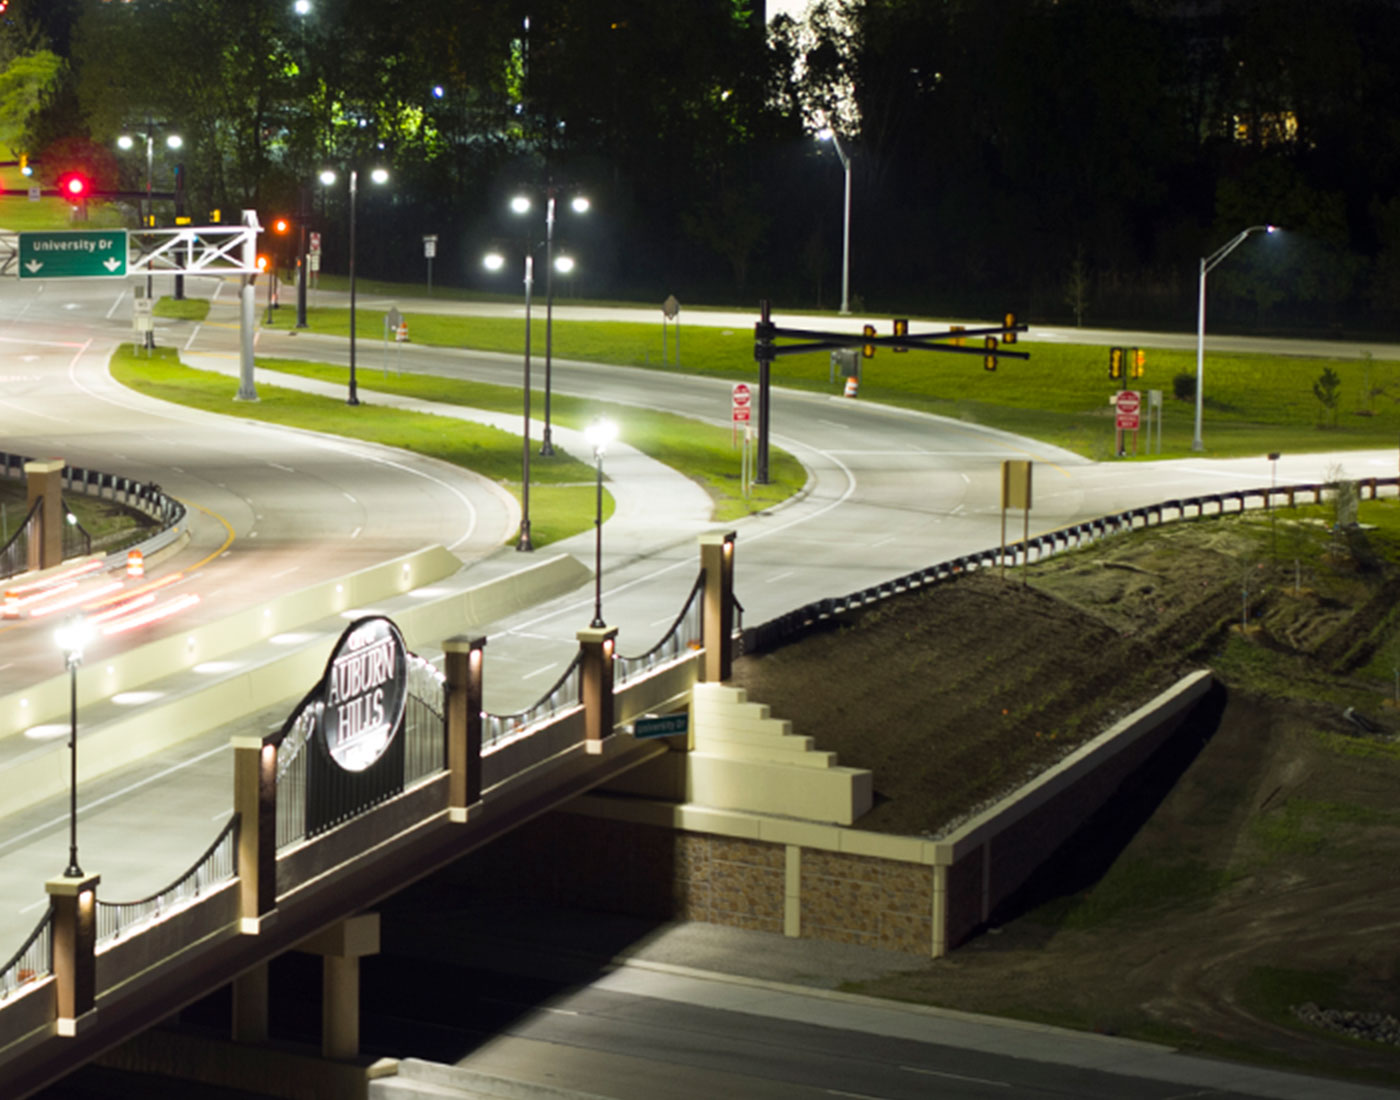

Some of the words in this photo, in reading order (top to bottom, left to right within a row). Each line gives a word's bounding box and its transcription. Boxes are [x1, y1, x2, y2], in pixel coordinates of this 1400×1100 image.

[33, 240, 96, 253] University
[98, 239, 113, 250] Dr
[328, 641, 395, 707] AUBURN
[338, 688, 384, 745] HILLS
